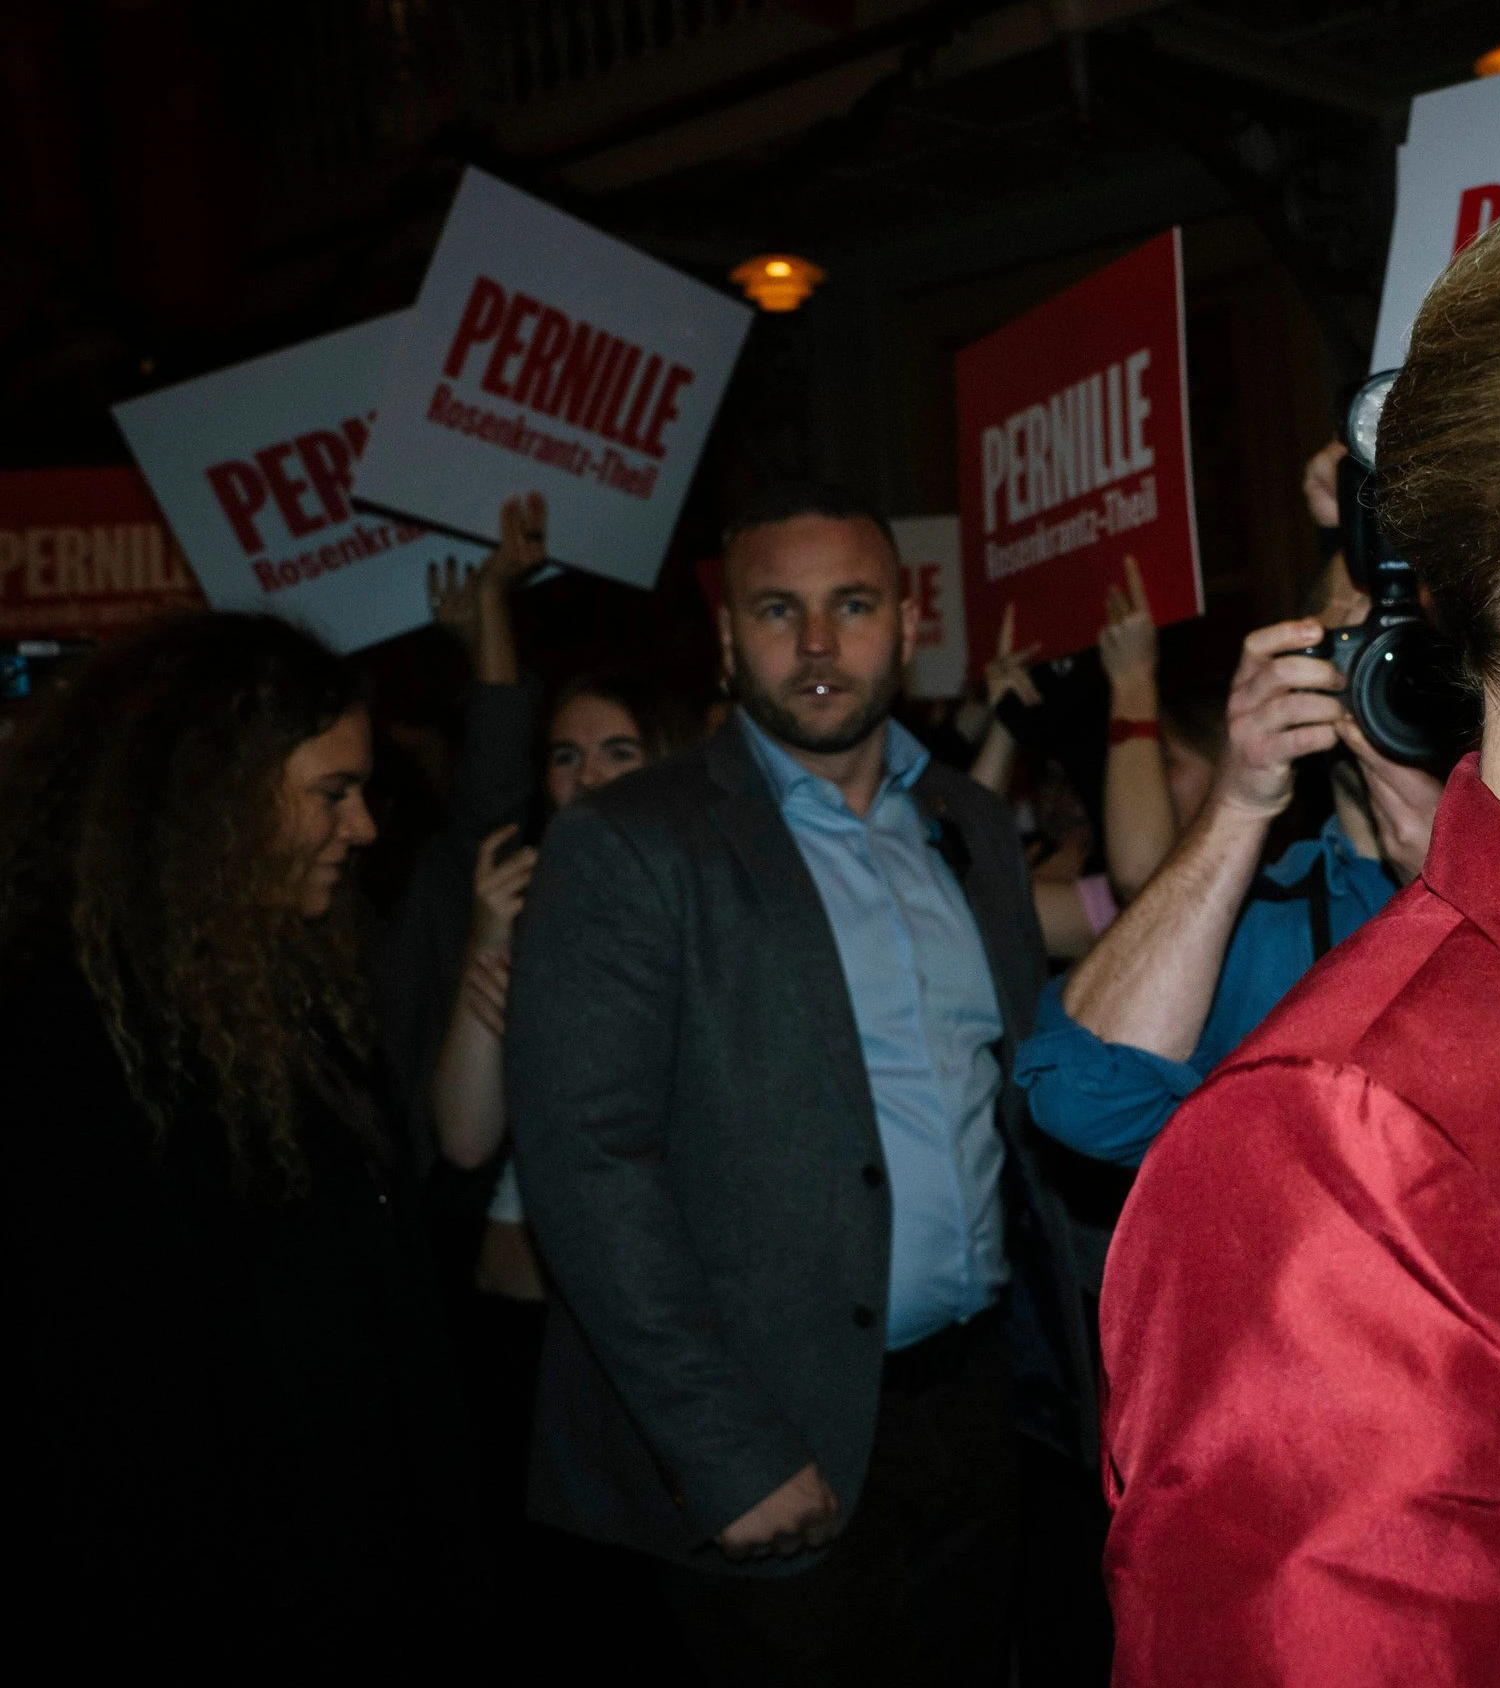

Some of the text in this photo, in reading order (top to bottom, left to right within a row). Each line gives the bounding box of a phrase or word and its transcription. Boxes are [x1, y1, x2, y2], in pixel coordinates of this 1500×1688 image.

[443, 274, 694, 459] PERNILLE
[981, 348, 1156, 536] PERNILLE
[205, 411, 378, 555] PER
